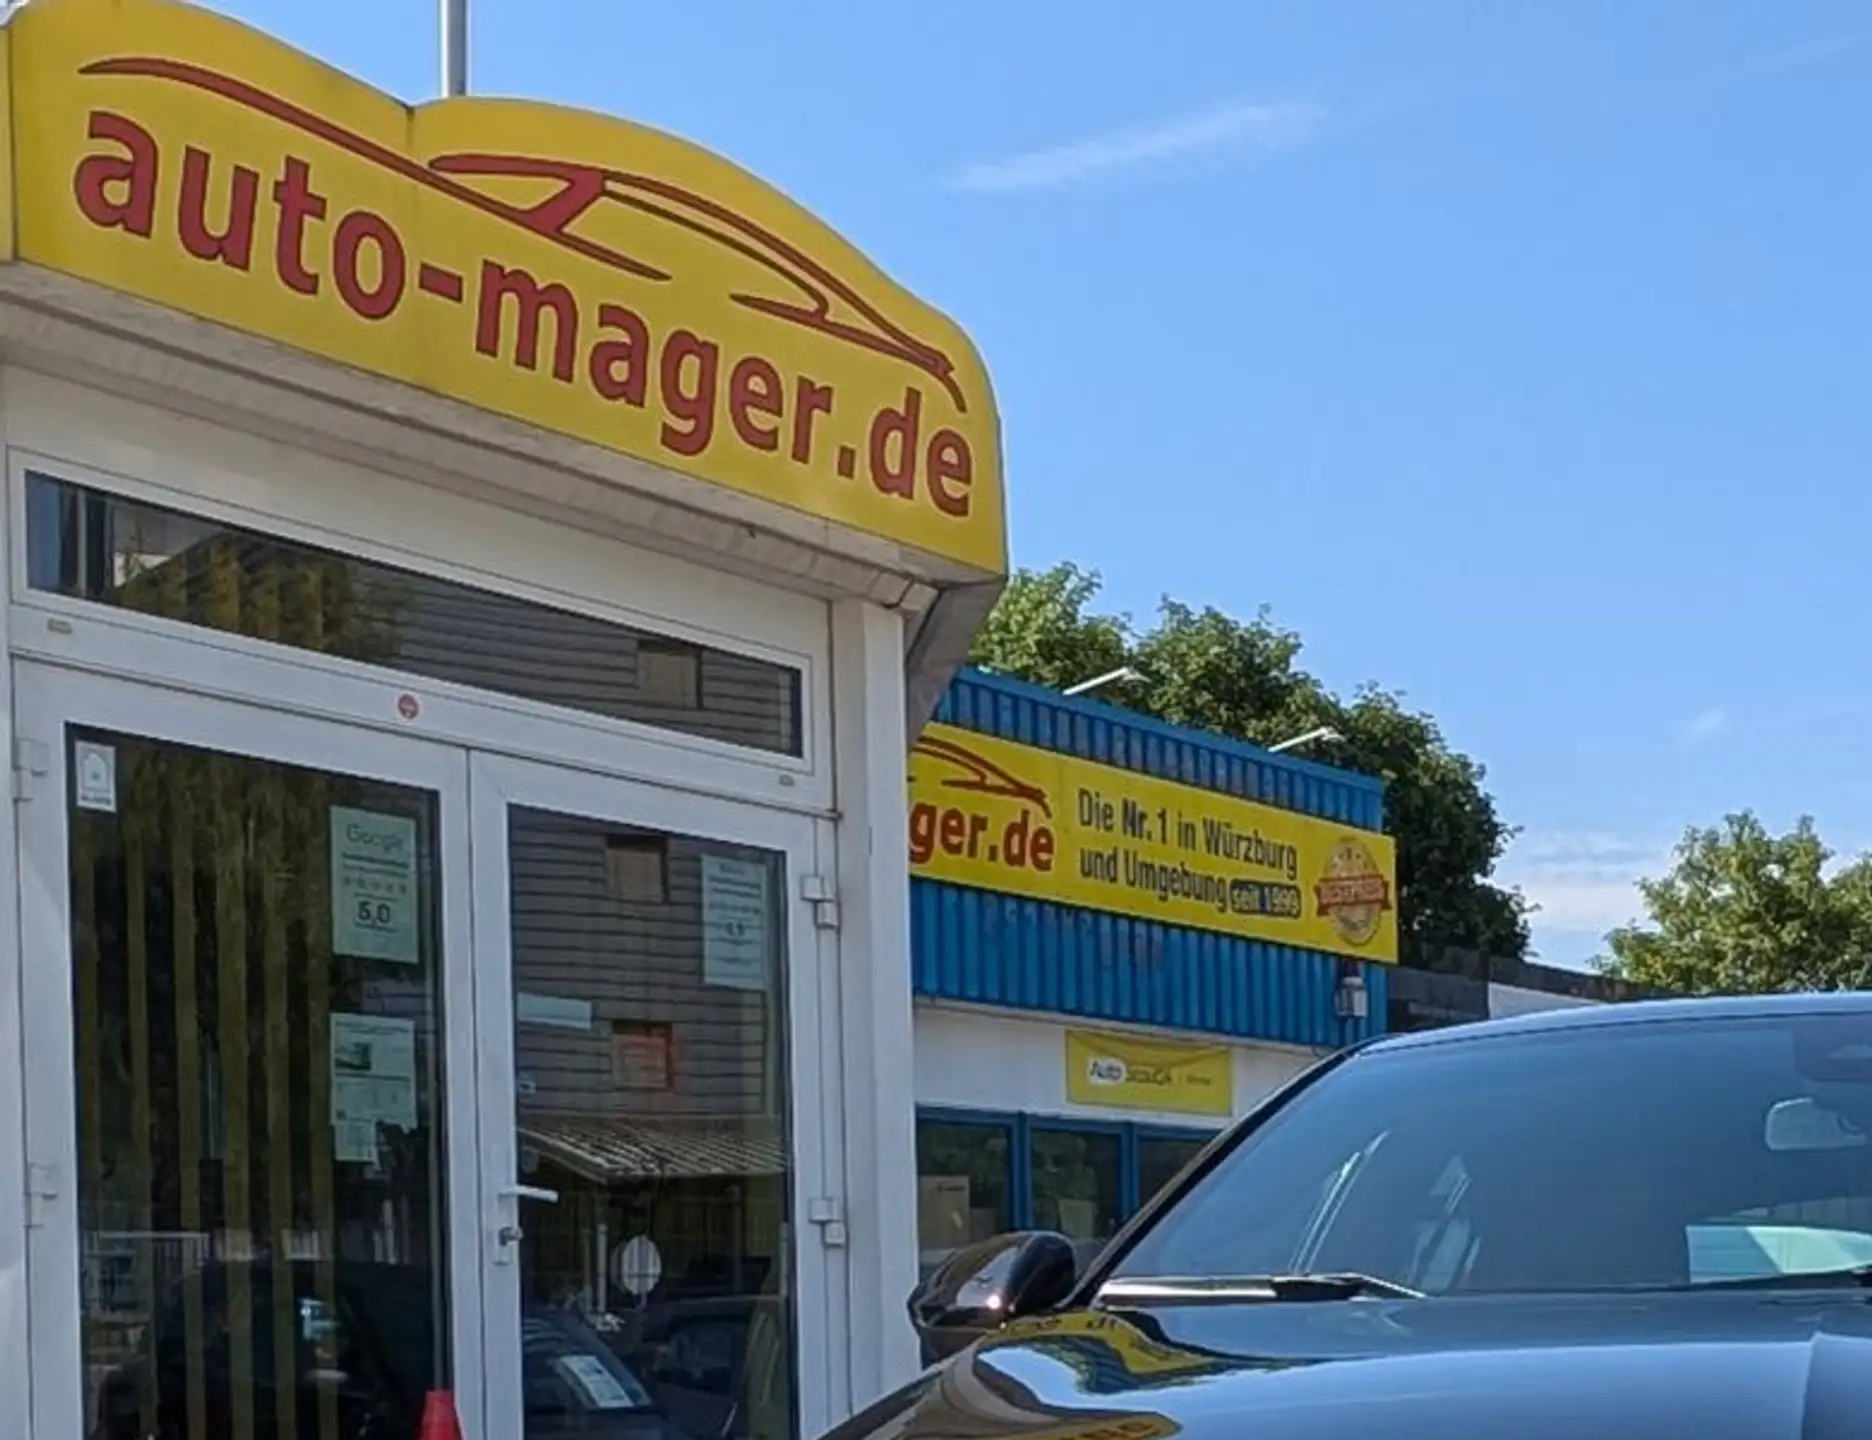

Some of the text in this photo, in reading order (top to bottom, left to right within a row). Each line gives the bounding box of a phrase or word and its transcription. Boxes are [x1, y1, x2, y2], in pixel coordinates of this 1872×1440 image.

[72, 108, 974, 519] auto-mager.de
[1077, 787, 1298, 881] Die Nr. 1 in Würzburg
[1079, 846, 1118, 884] und
[1123, 848, 1229, 914] Umgebung
